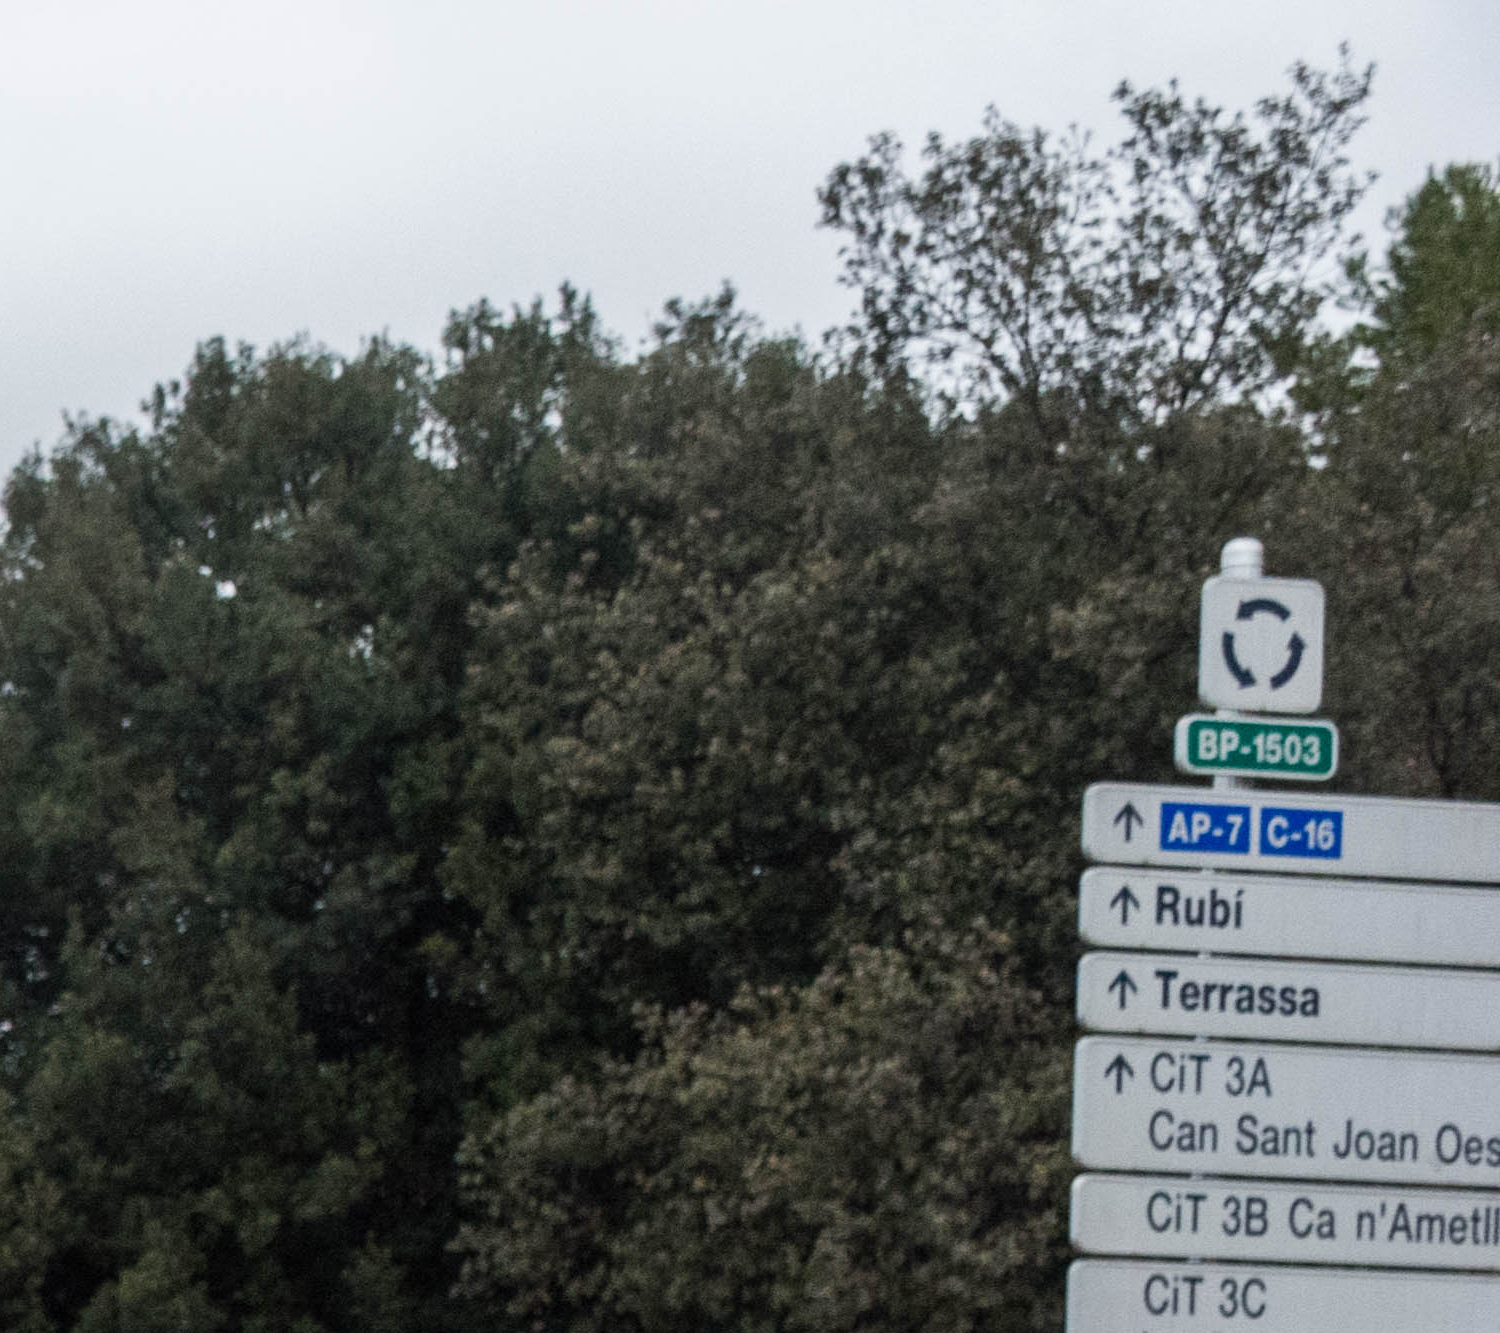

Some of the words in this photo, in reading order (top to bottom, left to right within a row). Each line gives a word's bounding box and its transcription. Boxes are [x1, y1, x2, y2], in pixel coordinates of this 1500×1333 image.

[1199, 729, 1321, 767] BP-1503
[1167, 810, 1244, 846] AP-7
[1266, 816, 1336, 851] C-16
[1154, 885, 1245, 929] Rubí
[1154, 969, 1321, 1018] Terrassa
[1225, 1055, 1272, 1098] 3A
[1148, 1109, 1218, 1153] Can
[1235, 1113, 1315, 1158] Sant
[1333, 1119, 1418, 1163] Joan
[1221, 1195, 1269, 1238] 3B
[1288, 1197, 1336, 1241] Ca
[1218, 1277, 1267, 1320] 3C
